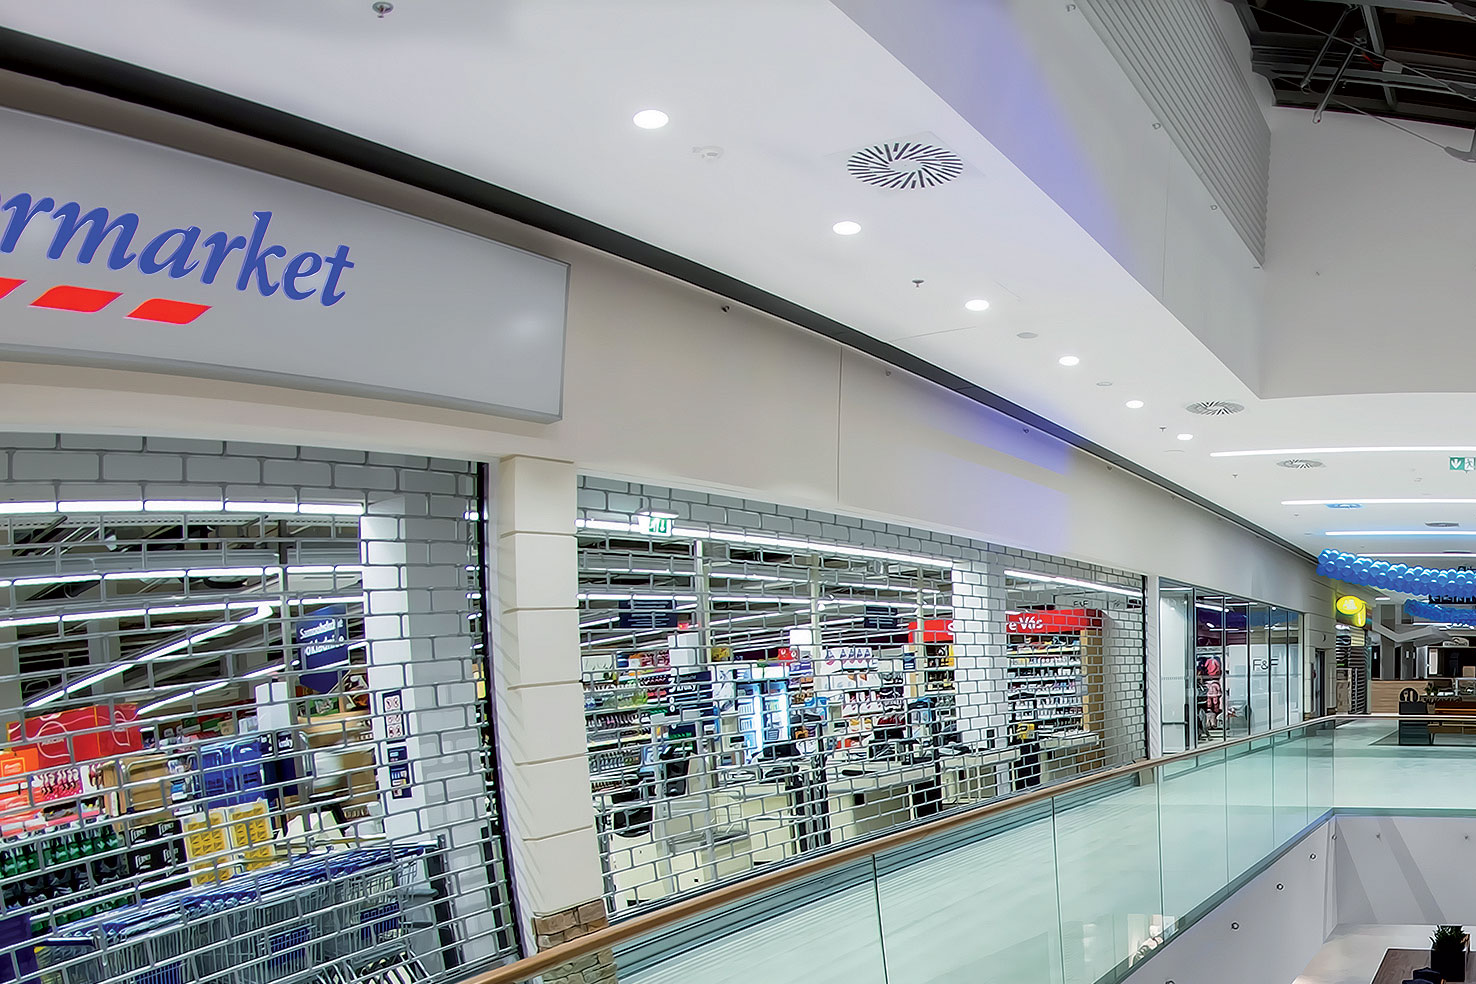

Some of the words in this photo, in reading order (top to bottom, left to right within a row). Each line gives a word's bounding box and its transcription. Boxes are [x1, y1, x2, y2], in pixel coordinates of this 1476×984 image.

[0, 193, 355, 306] rmarket
[1018, 615, 1043, 630] Vás
[1252, 659, 1279, 671] F&F
